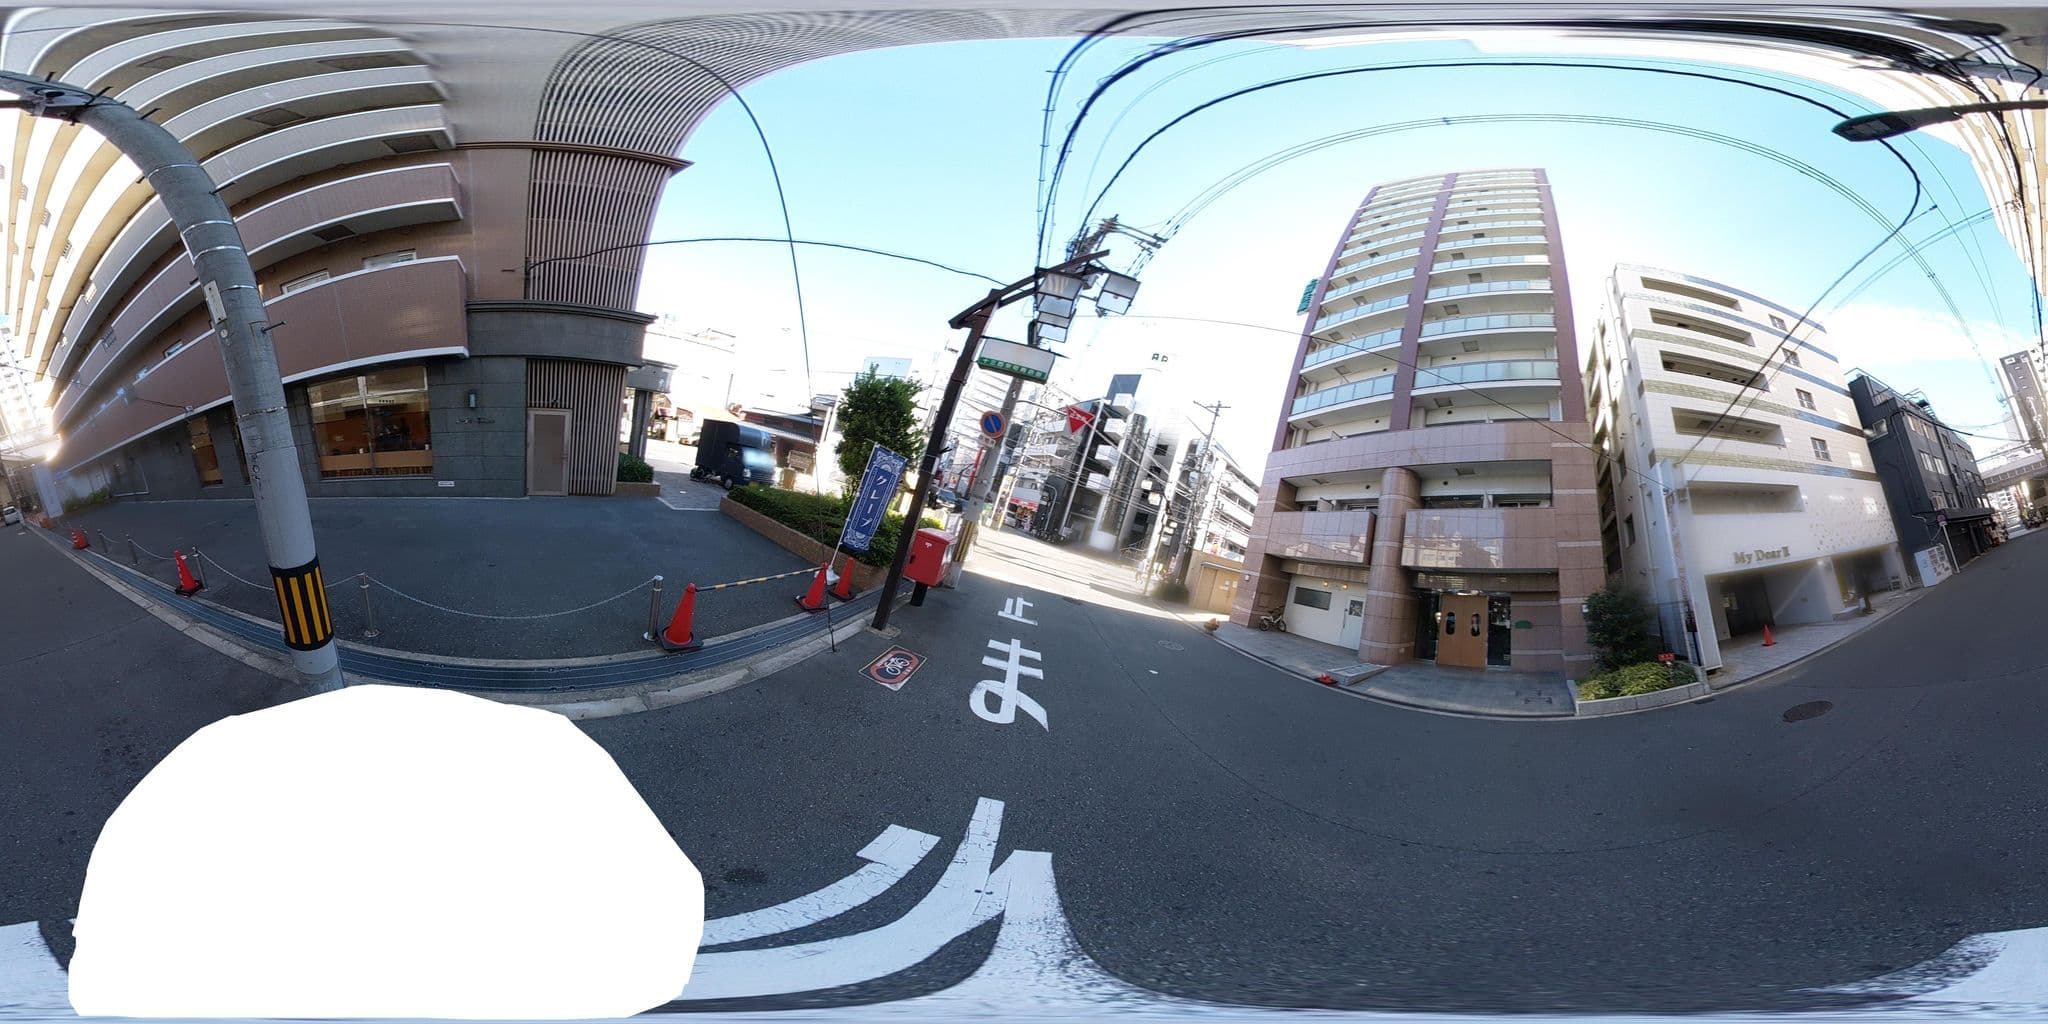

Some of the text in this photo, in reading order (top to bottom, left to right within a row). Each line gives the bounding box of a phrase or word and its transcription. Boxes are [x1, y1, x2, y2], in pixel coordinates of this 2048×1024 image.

[861, 475, 888, 527] クレープ
[1733, 552, 1753, 565] My
